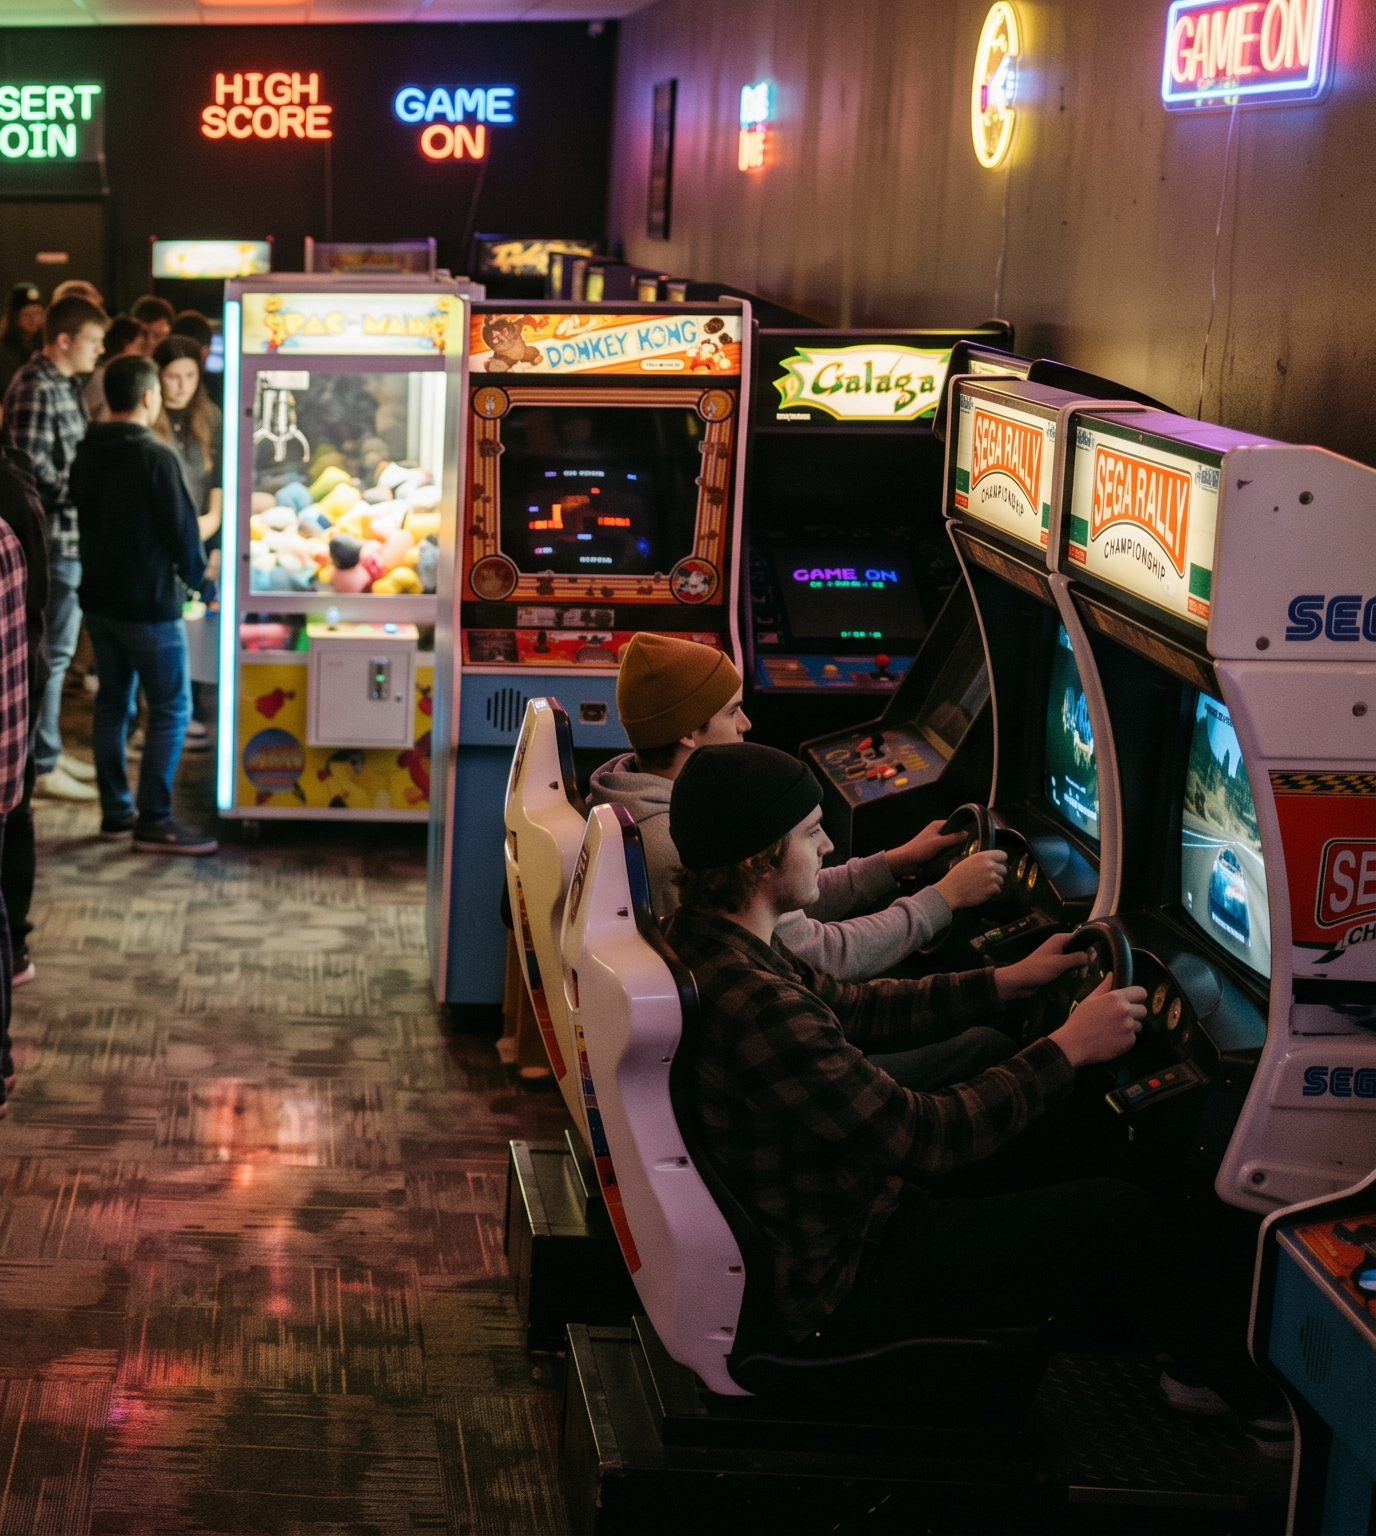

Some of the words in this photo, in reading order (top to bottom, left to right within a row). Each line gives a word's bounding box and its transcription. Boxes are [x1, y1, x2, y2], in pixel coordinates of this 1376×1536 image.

[1171, 3, 1260, 83] GAME
[1260, 0, 1313, 72] ON
[214, 71, 319, 106] HIGH
[393, 86, 515, 123] GAME
[201, 105, 333, 139] SCORE
[420, 123, 486, 160] ON
[545, 331, 629, 369] DONKEY
[636, 319, 697, 352] KONG
[810, 359, 937, 414] Galaga
[973, 415, 1003, 478] SEGA
[1004, 425, 1041, 499] RALLY
[1094, 452, 1132, 528] SEGA
[1134, 466, 1188, 559] RALLY
[792, 568, 858, 582] GAME
[864, 568, 899, 583] ON
[1103, 537, 1166, 582] CHAMPIONSHIP
